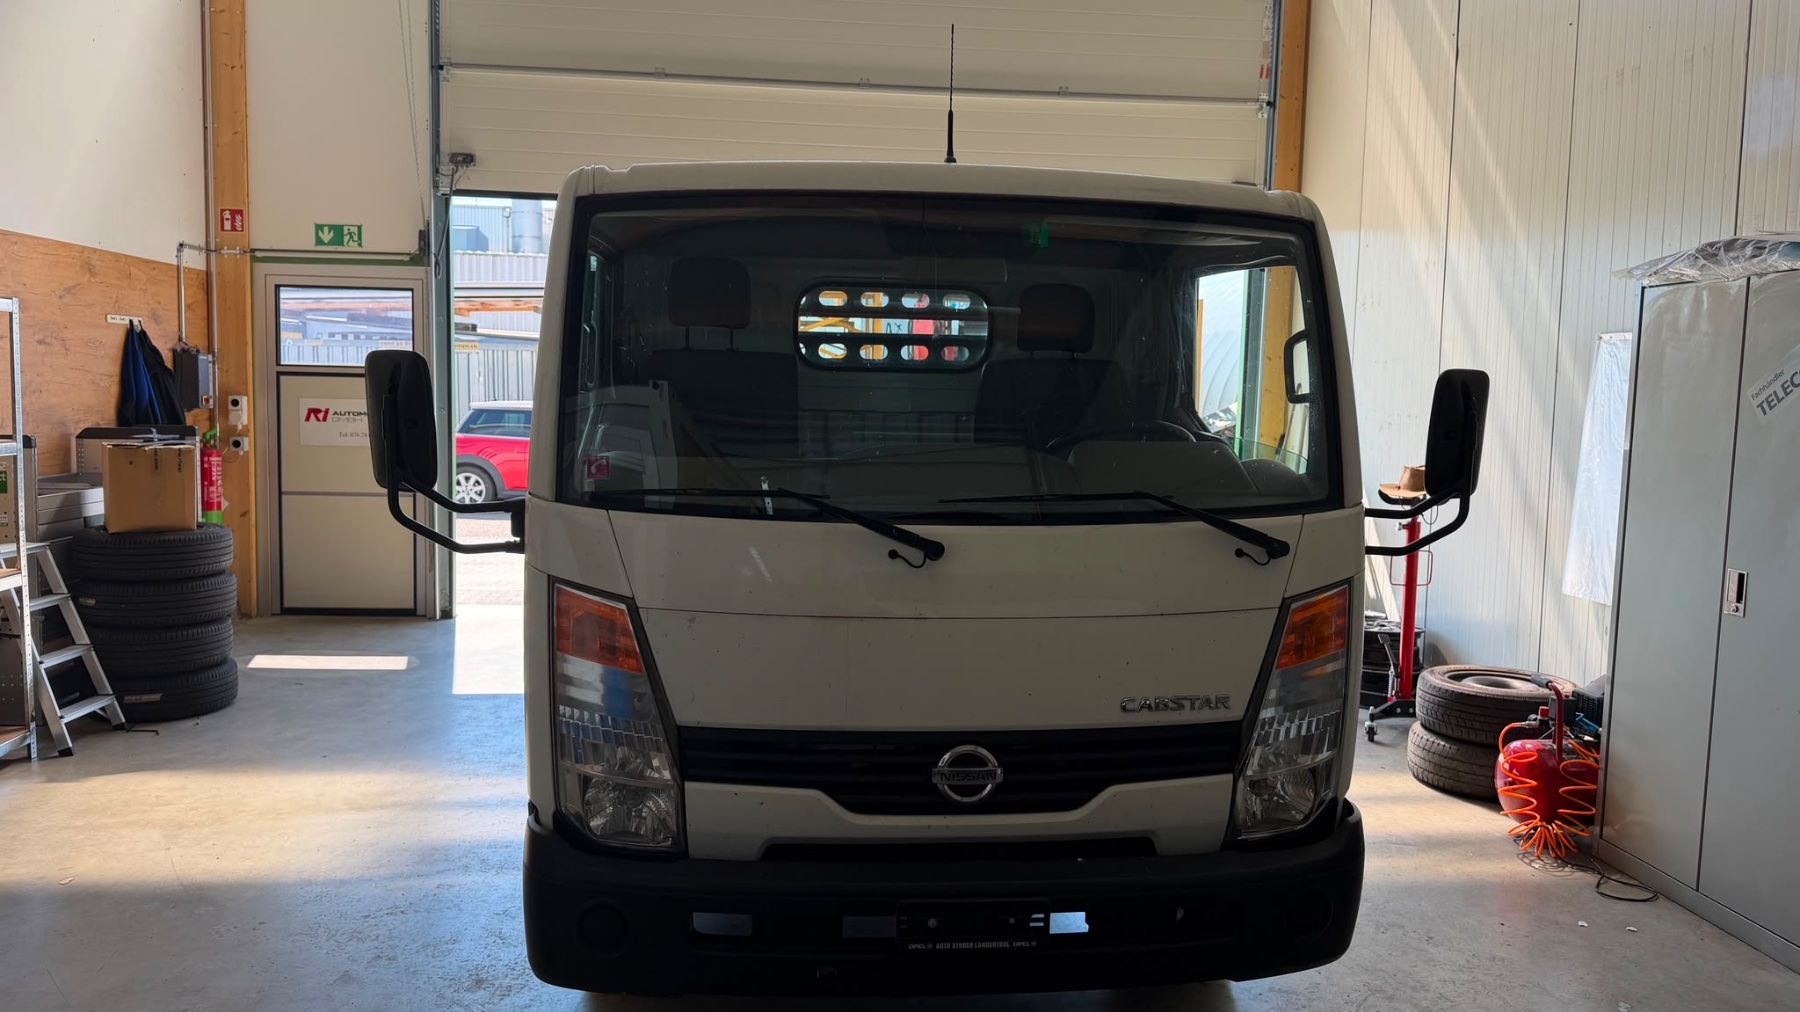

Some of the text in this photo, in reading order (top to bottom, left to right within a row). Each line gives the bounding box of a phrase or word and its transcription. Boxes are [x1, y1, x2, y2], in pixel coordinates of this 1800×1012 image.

[1756, 371, 1800, 416] TELEC
[304, 407, 330, 423] RI
[1120, 694, 1231, 713] CABSTAR
[940, 772, 996, 782] NISSAN
